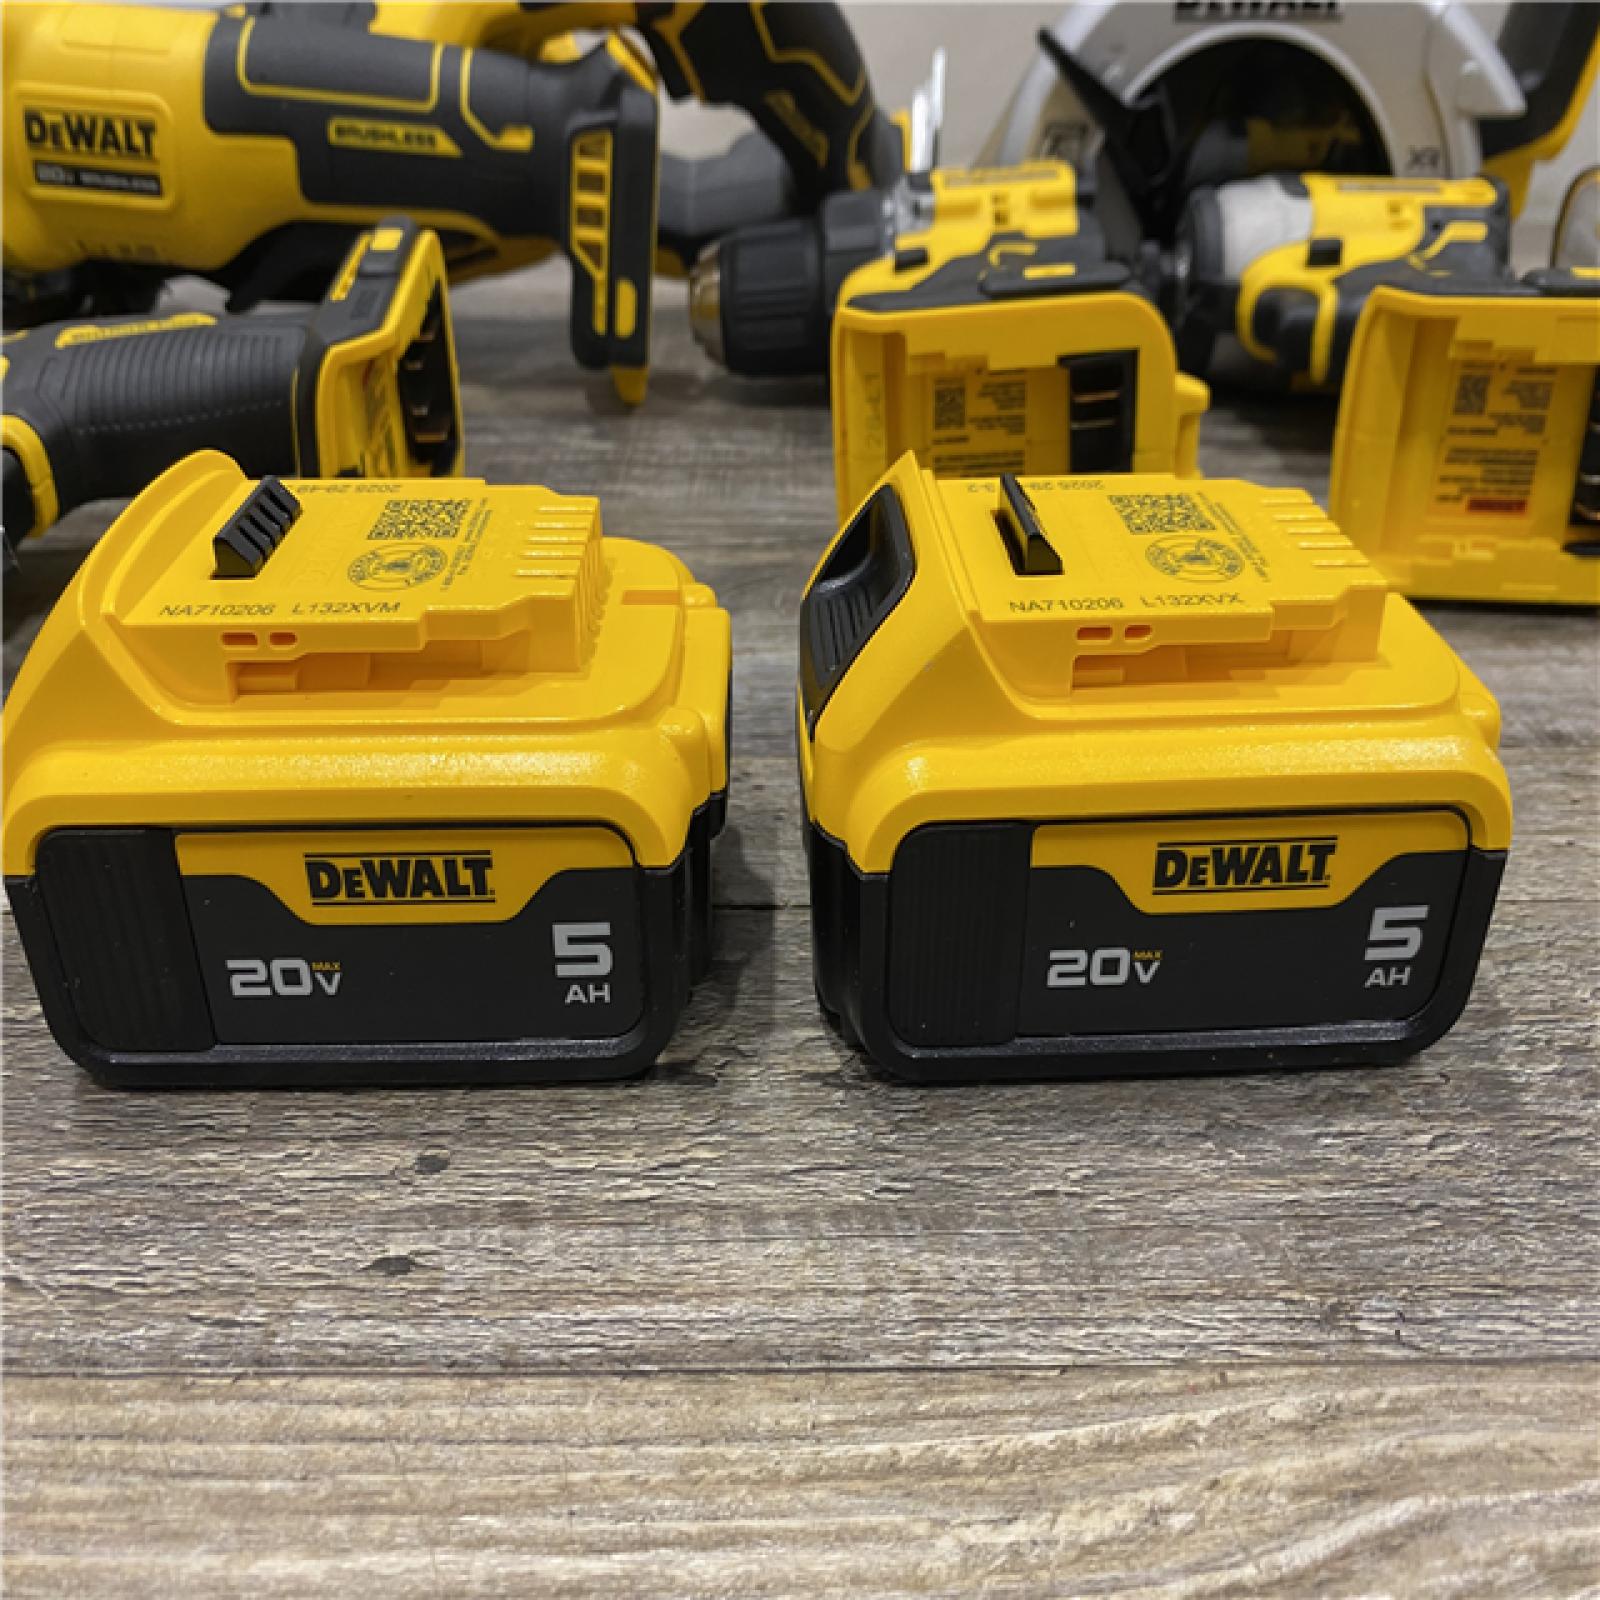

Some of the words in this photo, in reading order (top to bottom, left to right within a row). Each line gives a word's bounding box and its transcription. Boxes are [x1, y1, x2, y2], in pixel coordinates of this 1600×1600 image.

[159, 603, 276, 617] NA710206
[291, 601, 401, 614] L132XVM
[1009, 597, 1124, 613] NA710206
[304, 858, 495, 899] DEWALT
[1153, 844, 1337, 889] DEWALT
[1364, 904, 1430, 961] 5
[552, 922, 613, 978] 5
[564, 982, 611, 1004] AH
[1364, 966, 1411, 989] AH
